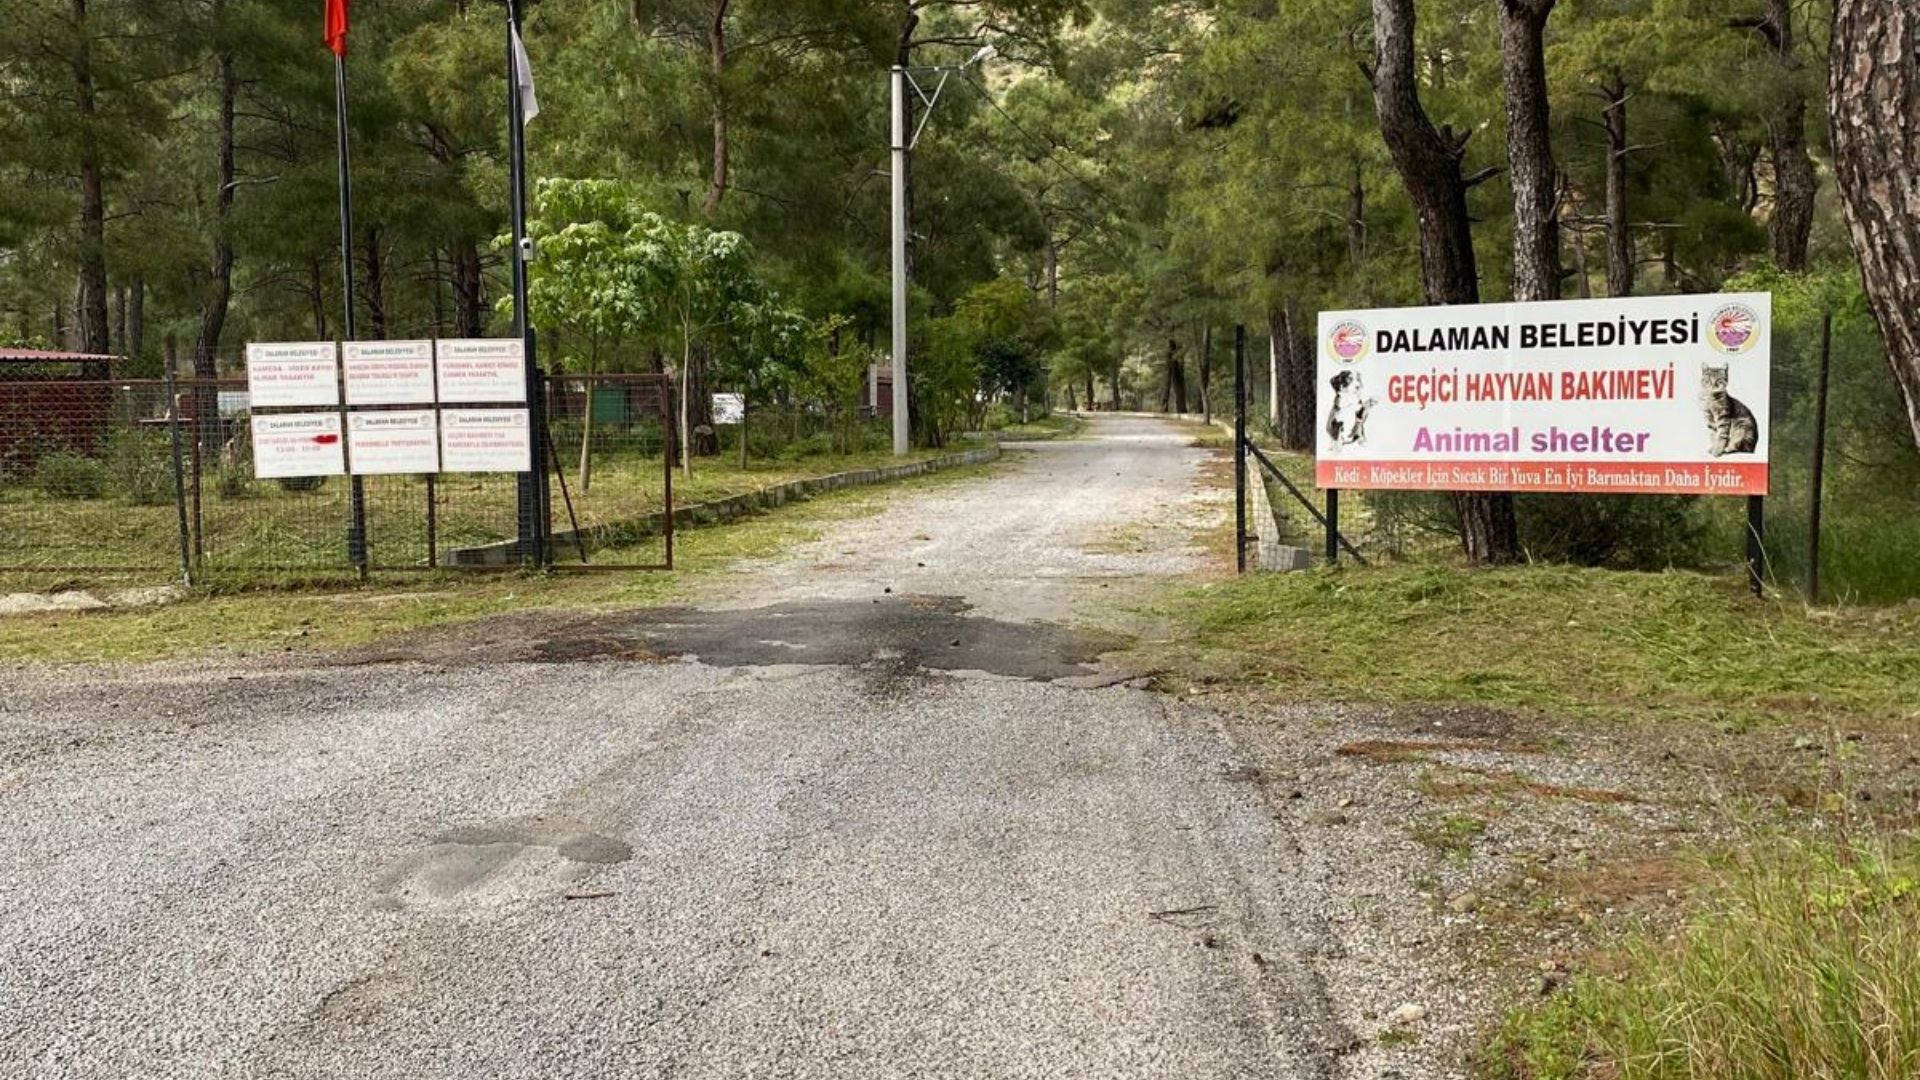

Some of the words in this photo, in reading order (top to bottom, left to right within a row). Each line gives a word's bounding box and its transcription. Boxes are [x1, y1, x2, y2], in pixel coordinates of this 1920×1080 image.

[1376, 325, 1510, 354] DALAMAN
[1520, 312, 1699, 349] BELEDİYESİ
[1388, 368, 1458, 410] GEÇİCİ
[1466, 372, 1553, 402] HAYVAN
[1561, 362, 1675, 400] BAKIMEVİ
[1412, 427, 1519, 453] Animal
[1531, 426, 1650, 453] shelter
[1335, 466, 1360, 483] Kedi
[1489, 467, 1509, 484] Bir
[1511, 467, 1541, 485] Yuva
[1544, 468, 1562, 485] En
[1566, 464, 1583, 489] İyi
[1664, 468, 1700, 487] Daha
